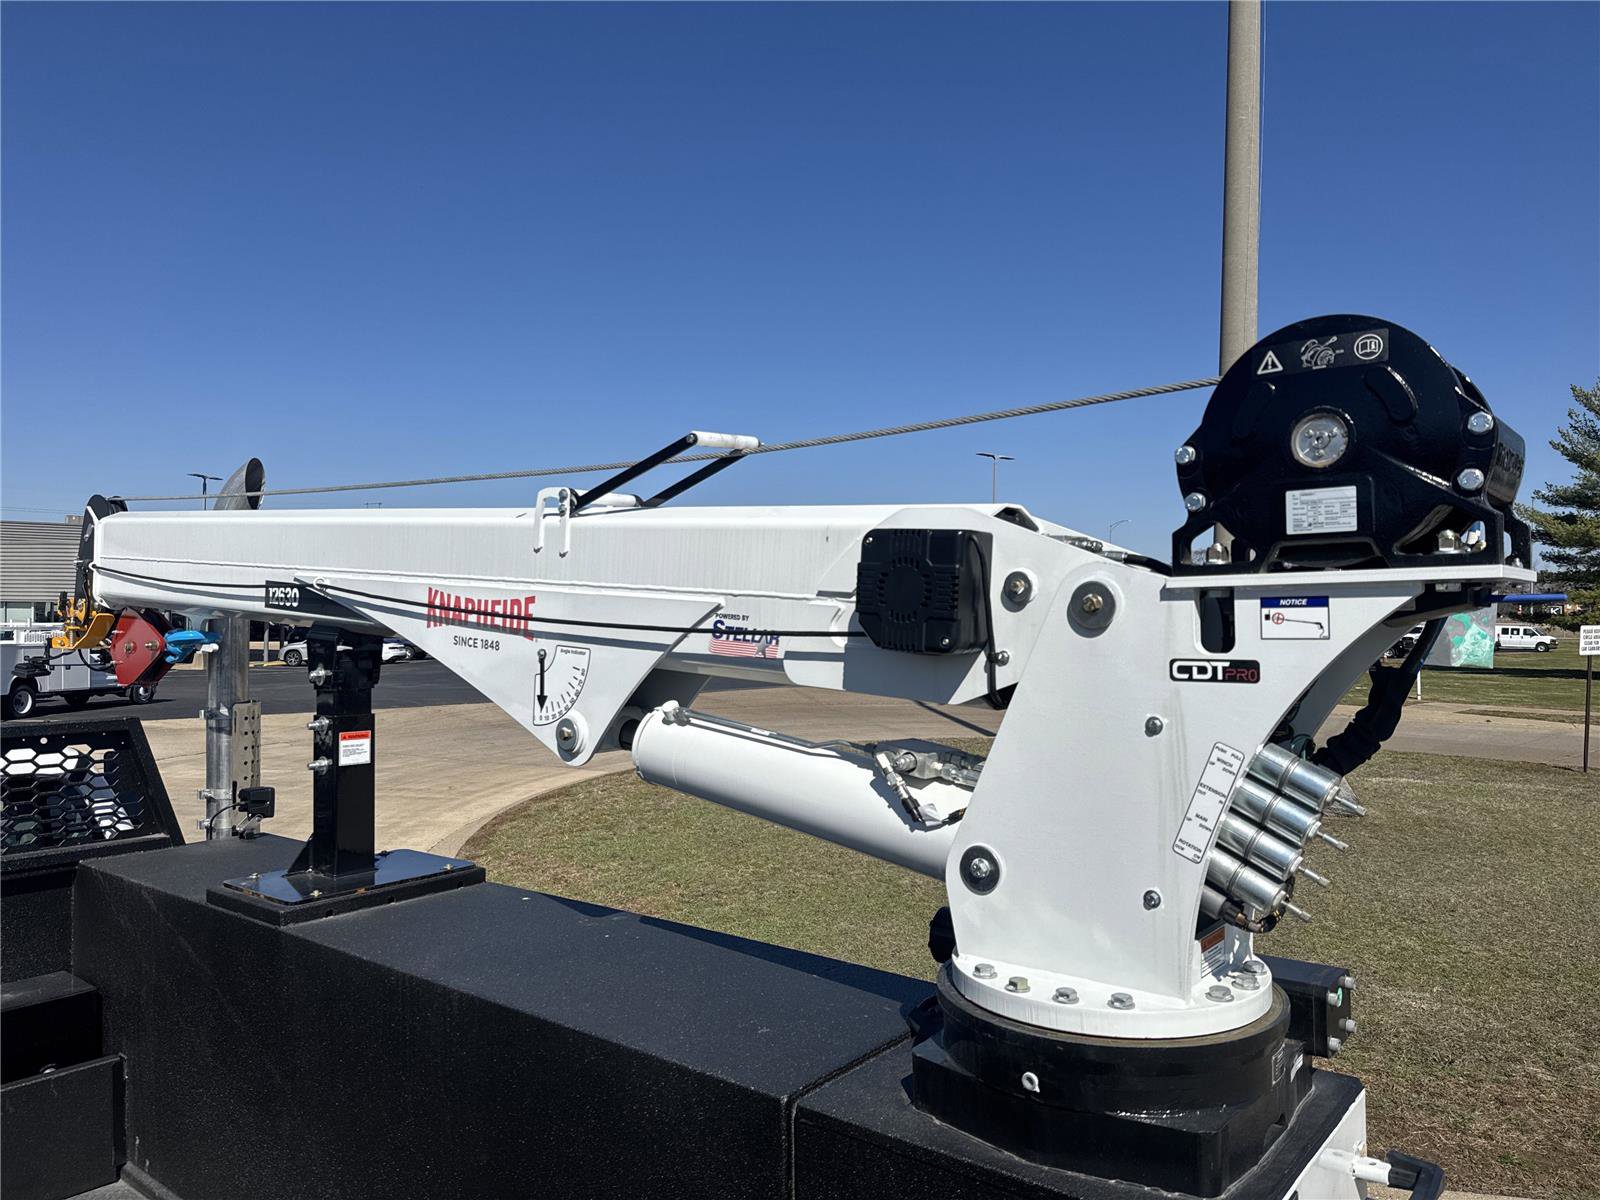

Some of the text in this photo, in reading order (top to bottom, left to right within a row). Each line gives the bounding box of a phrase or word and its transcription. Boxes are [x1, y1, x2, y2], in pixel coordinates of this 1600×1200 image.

[268, 587, 300, 607] 12630
[1279, 598, 1308, 606] NOTICE
[427, 587, 536, 641] KNAPHEIDE
[715, 612, 750, 622] POWERED BY
[453, 635, 500, 651] SINCE 1848
[1199, 782, 1227, 799] EXTENSION
[1178, 838, 1202, 853] ROTATION
